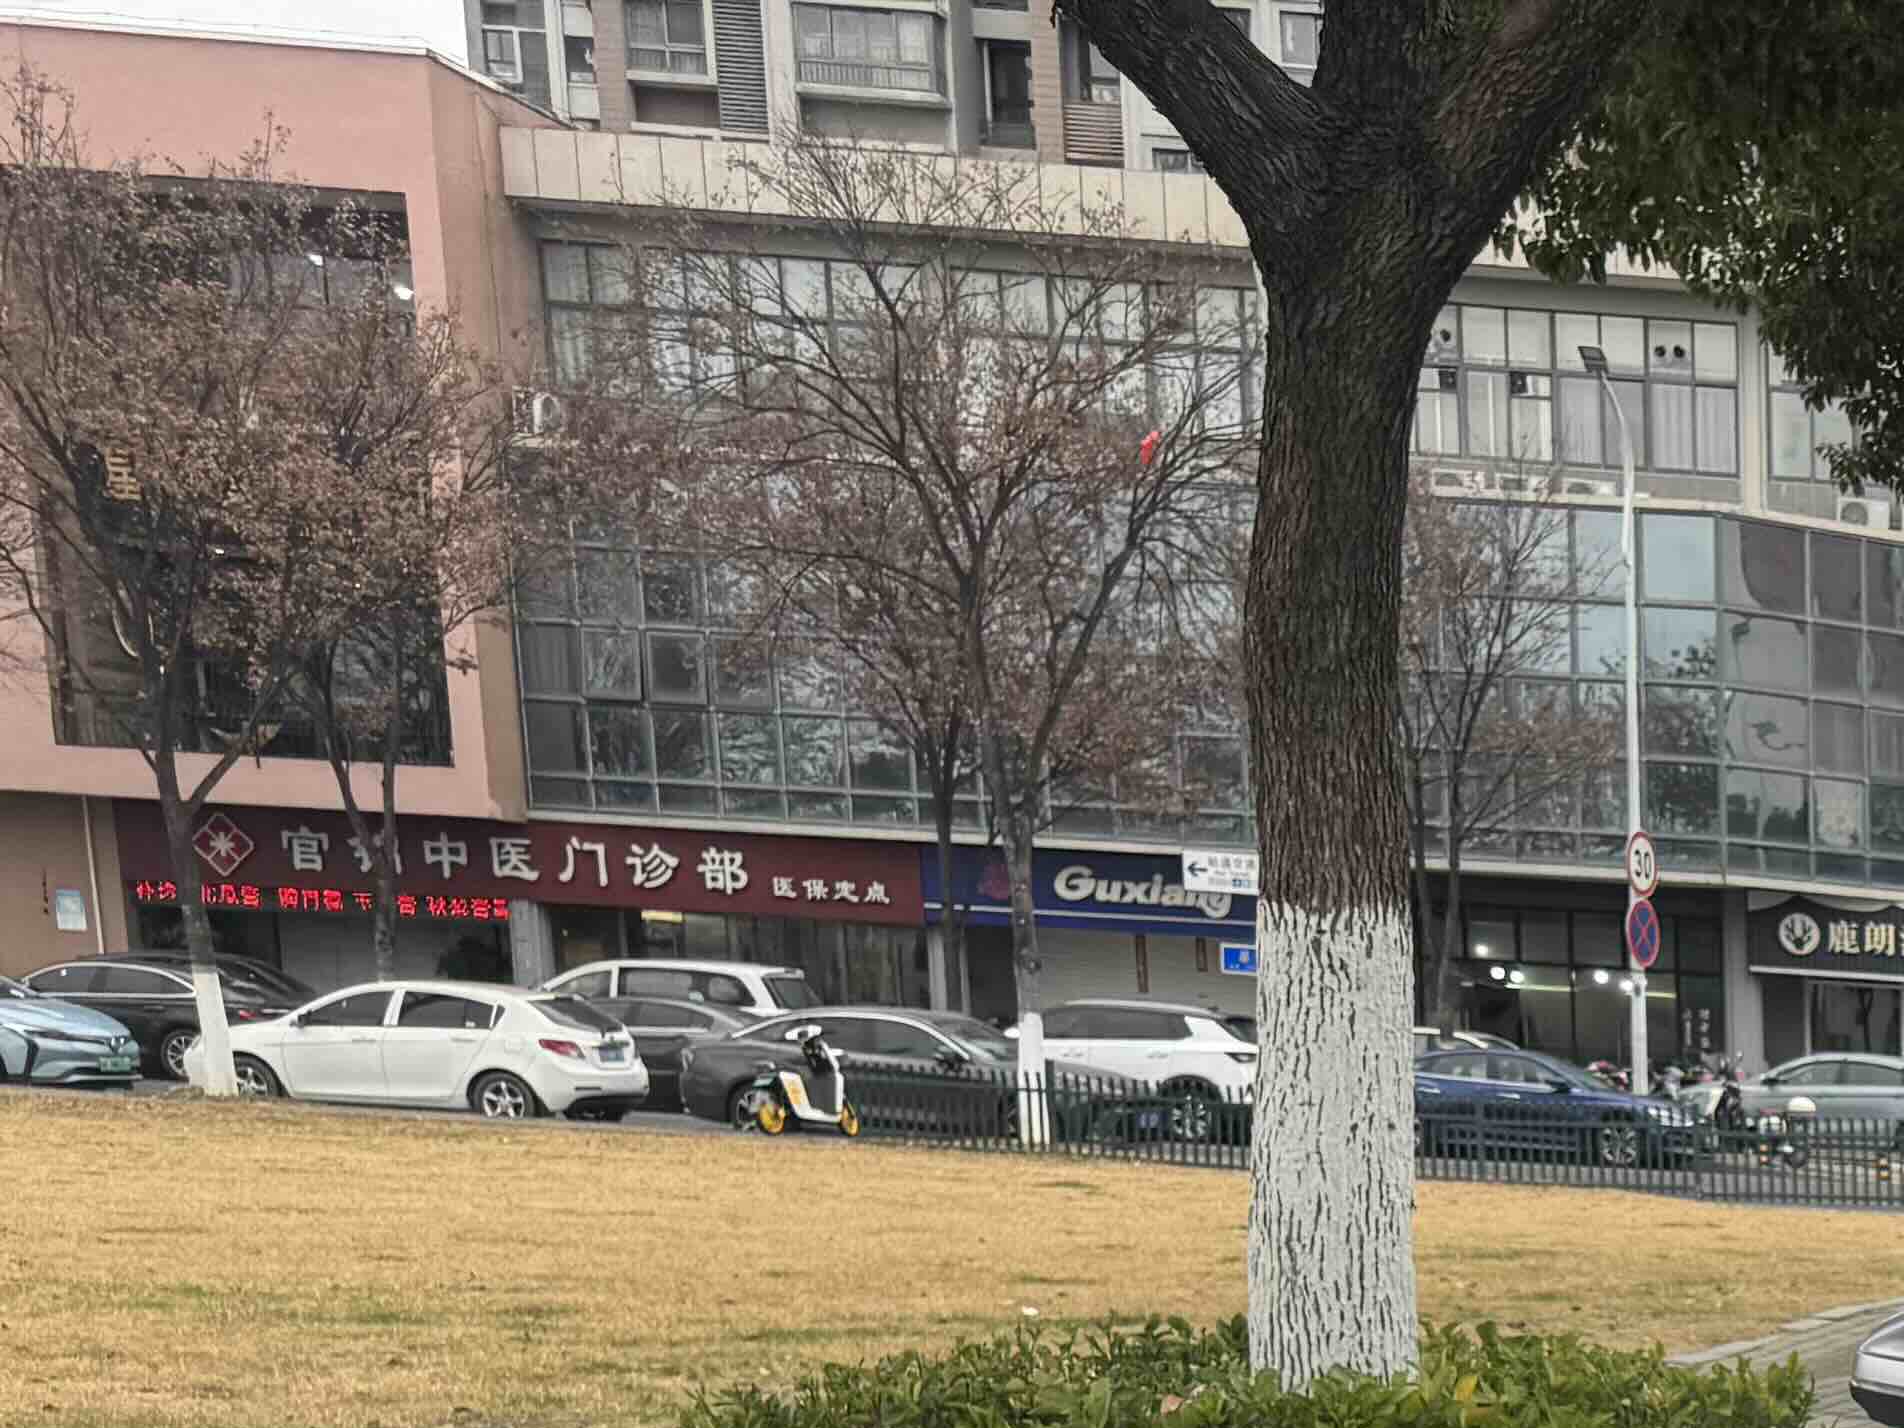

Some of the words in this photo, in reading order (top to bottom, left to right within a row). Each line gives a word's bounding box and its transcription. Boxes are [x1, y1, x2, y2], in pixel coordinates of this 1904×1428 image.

[1634, 848, 1652, 880] 30
[772, 876, 891, 905] 医保定点
[1053, 864, 1233, 920] Guxiang
